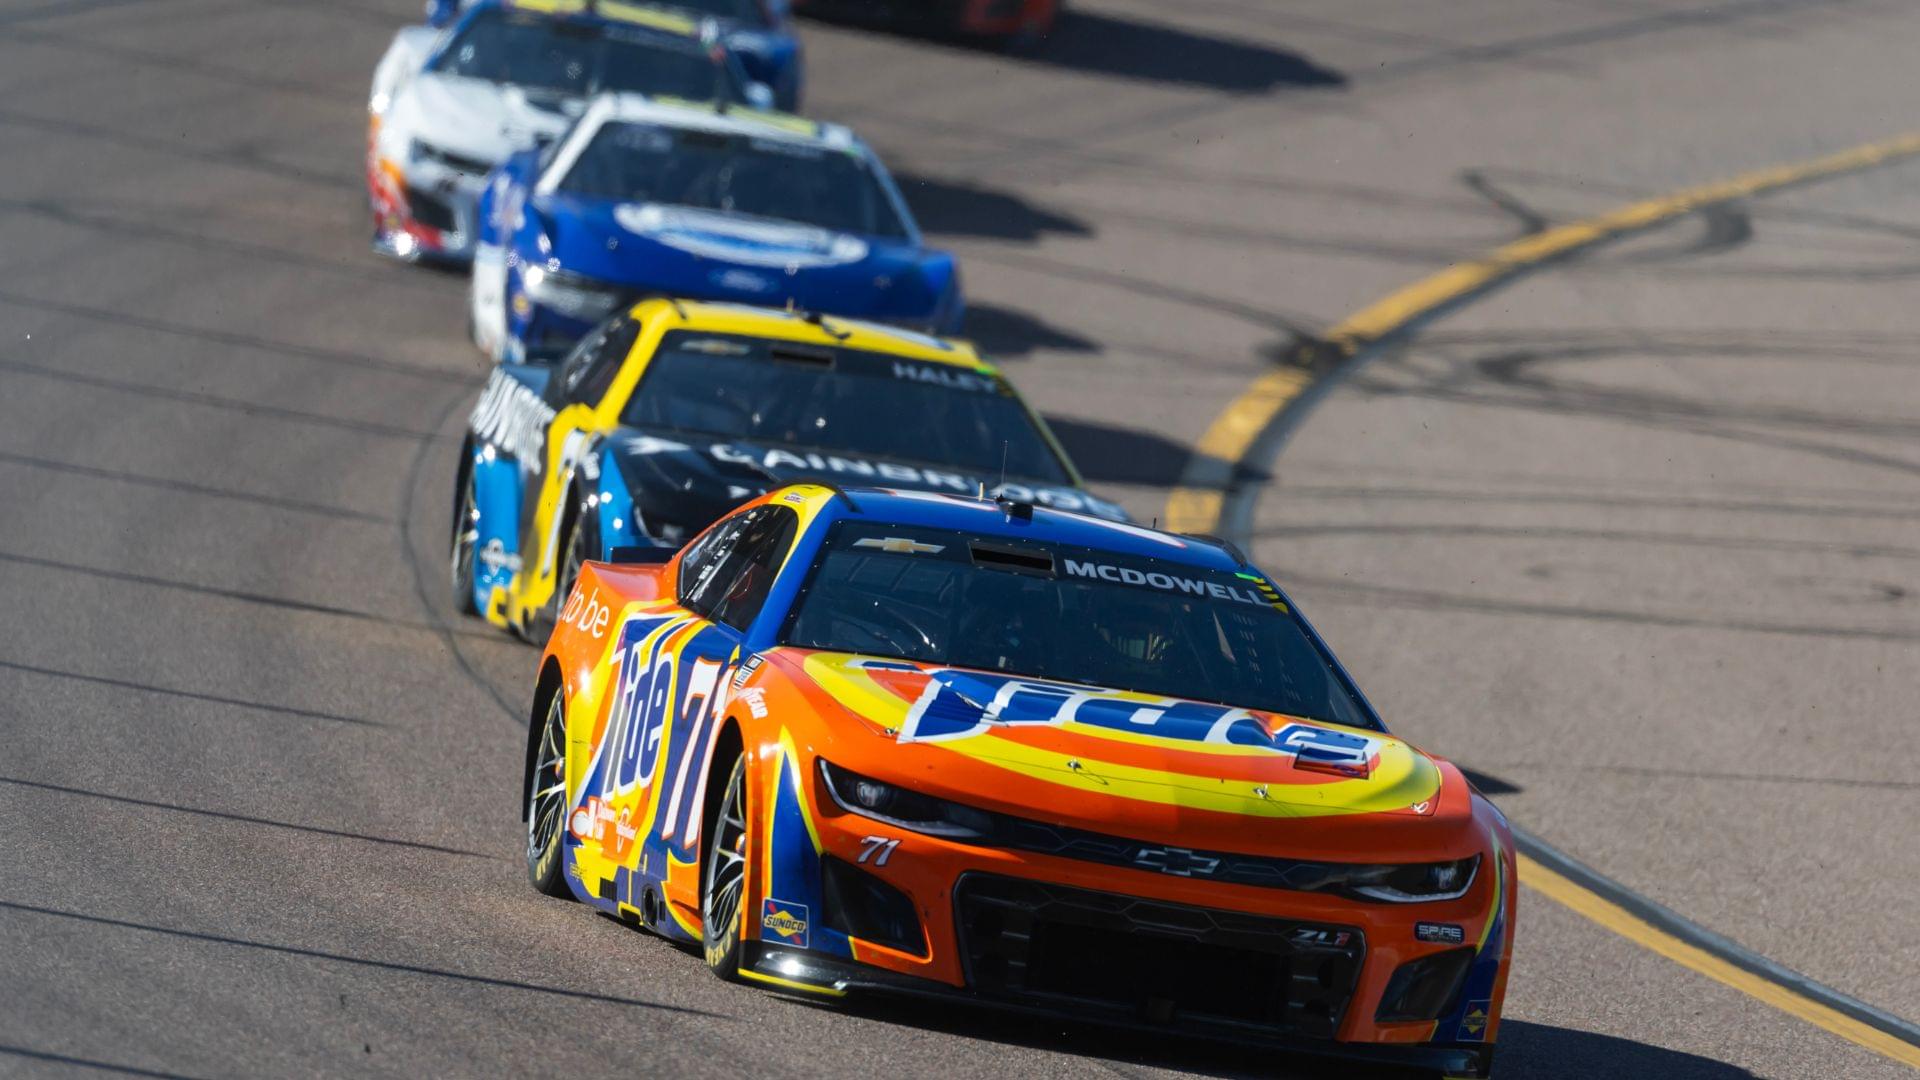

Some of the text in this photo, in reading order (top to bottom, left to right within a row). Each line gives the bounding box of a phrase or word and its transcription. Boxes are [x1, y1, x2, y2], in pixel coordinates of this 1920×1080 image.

[893, 361, 995, 394] HALEY
[1064, 558, 1273, 607] MCDOWELL
[562, 583, 609, 638] to be
[607, 612, 698, 801] Tide
[661, 655, 737, 849] 71
[857, 835, 901, 867] 71
[765, 915, 805, 932] SUNOCO
[1290, 929, 1351, 947] ZL1
